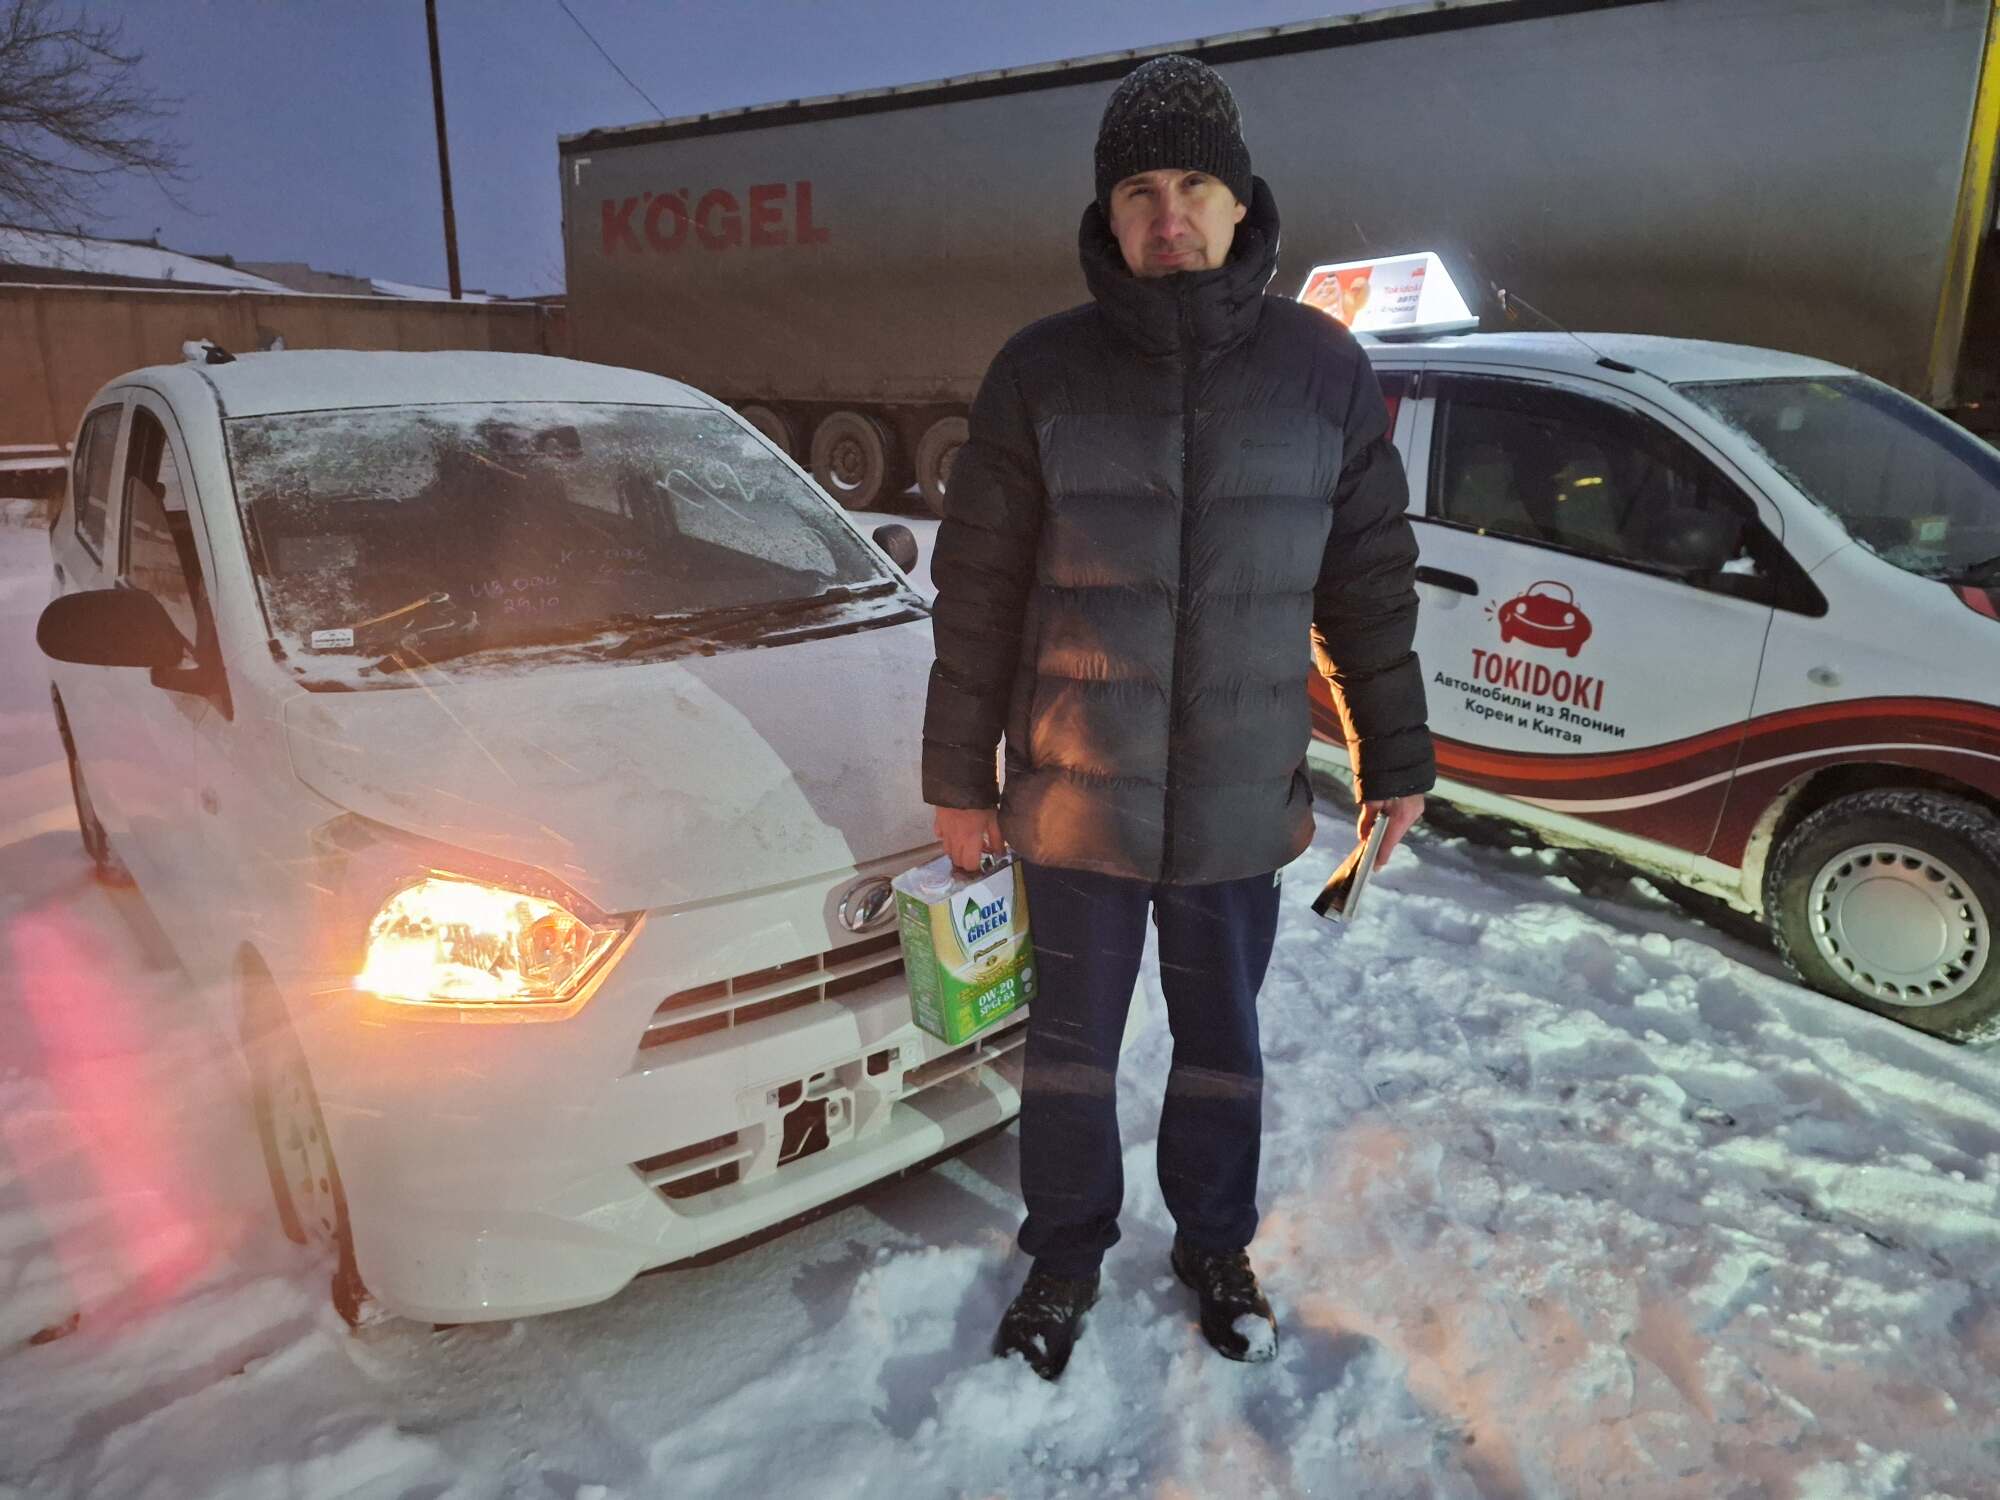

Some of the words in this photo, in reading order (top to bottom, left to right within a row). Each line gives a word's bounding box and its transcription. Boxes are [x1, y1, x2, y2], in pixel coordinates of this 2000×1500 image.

[601, 181, 830, 256] KÖGEL
[1434, 672, 1531, 711] Автомобили
[1535, 703, 1555, 717] из
[1559, 707, 1625, 738] Японии
[1472, 649, 1604, 711] TOKIDOKI
[1465, 698, 1513, 724] Кореи
[1518, 718, 1528, 728] и
[1532, 717, 1582, 744] Китая
[965, 896, 1005, 931] MOLY
[968, 911, 1008, 943] GREEN
